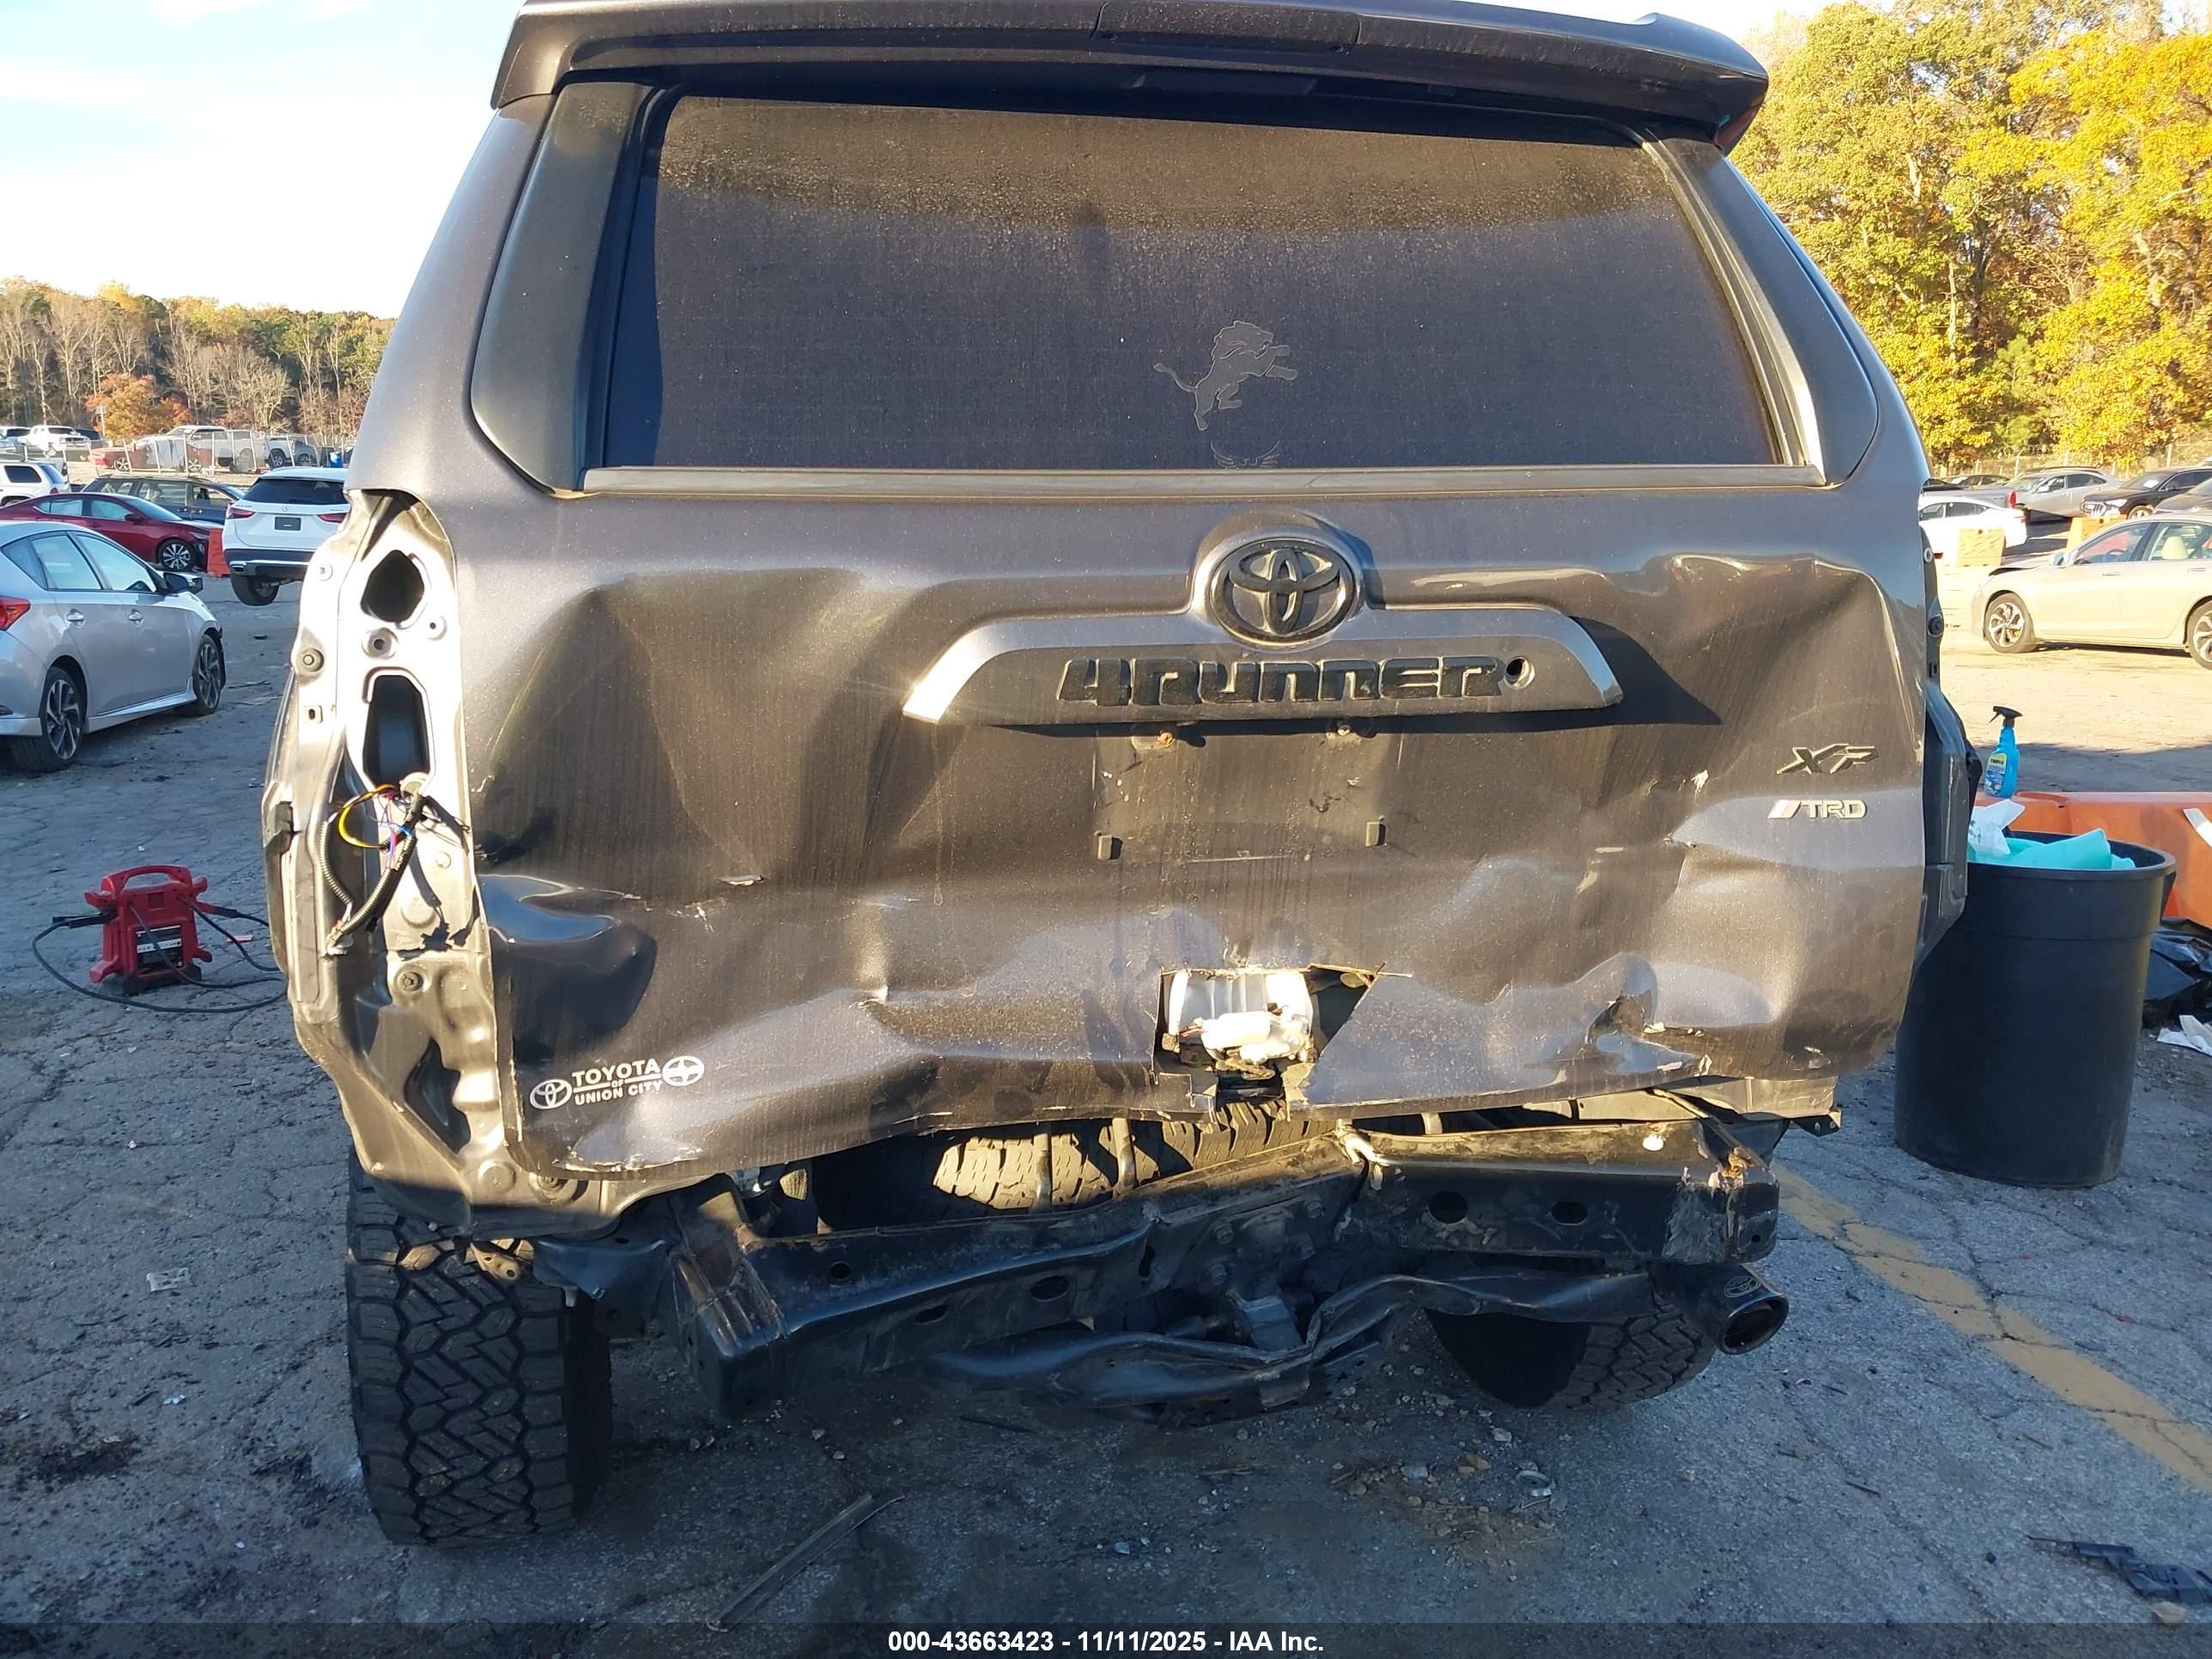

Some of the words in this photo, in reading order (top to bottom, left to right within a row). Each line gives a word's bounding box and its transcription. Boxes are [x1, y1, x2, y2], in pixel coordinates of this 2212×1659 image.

[1802, 799, 1868, 819] TRD
[572, 1059, 660, 1087] TOYOTA
[575, 1089, 623, 1105] UNION
[628, 1081, 663, 1096] CITY
